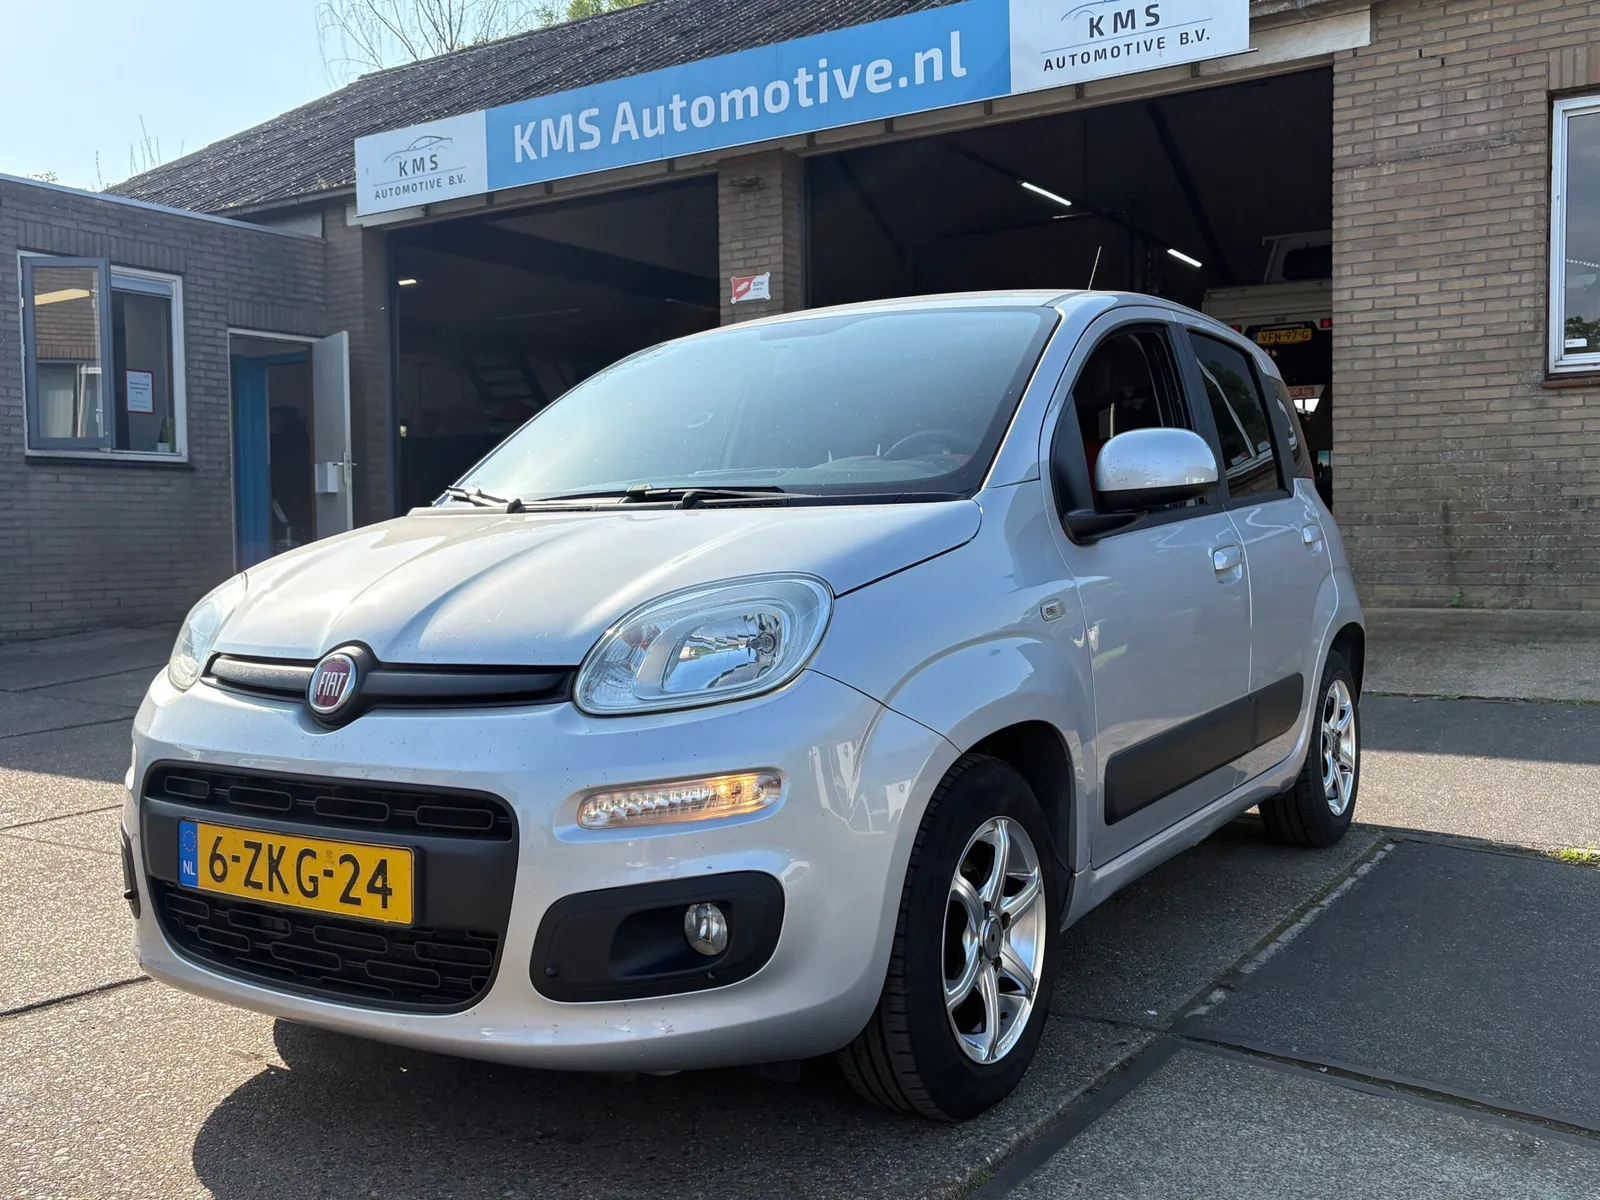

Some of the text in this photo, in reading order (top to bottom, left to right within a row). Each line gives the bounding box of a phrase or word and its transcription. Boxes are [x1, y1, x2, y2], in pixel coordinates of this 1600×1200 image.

[1089, 3, 1161, 38] KMS
[1043, 28, 1210, 72] AUTOMOTIVE B.V.
[513, 30, 967, 164] KMS Automotive.nl
[399, 154, 439, 177] KMS
[374, 174, 466, 200] AUTOMOTIVE B.V.
[1261, 330, 1309, 342] VFN-97-G
[317, 672, 347, 697] FIAT
[183, 835, 393, 909] NL 6-ZKG-24
